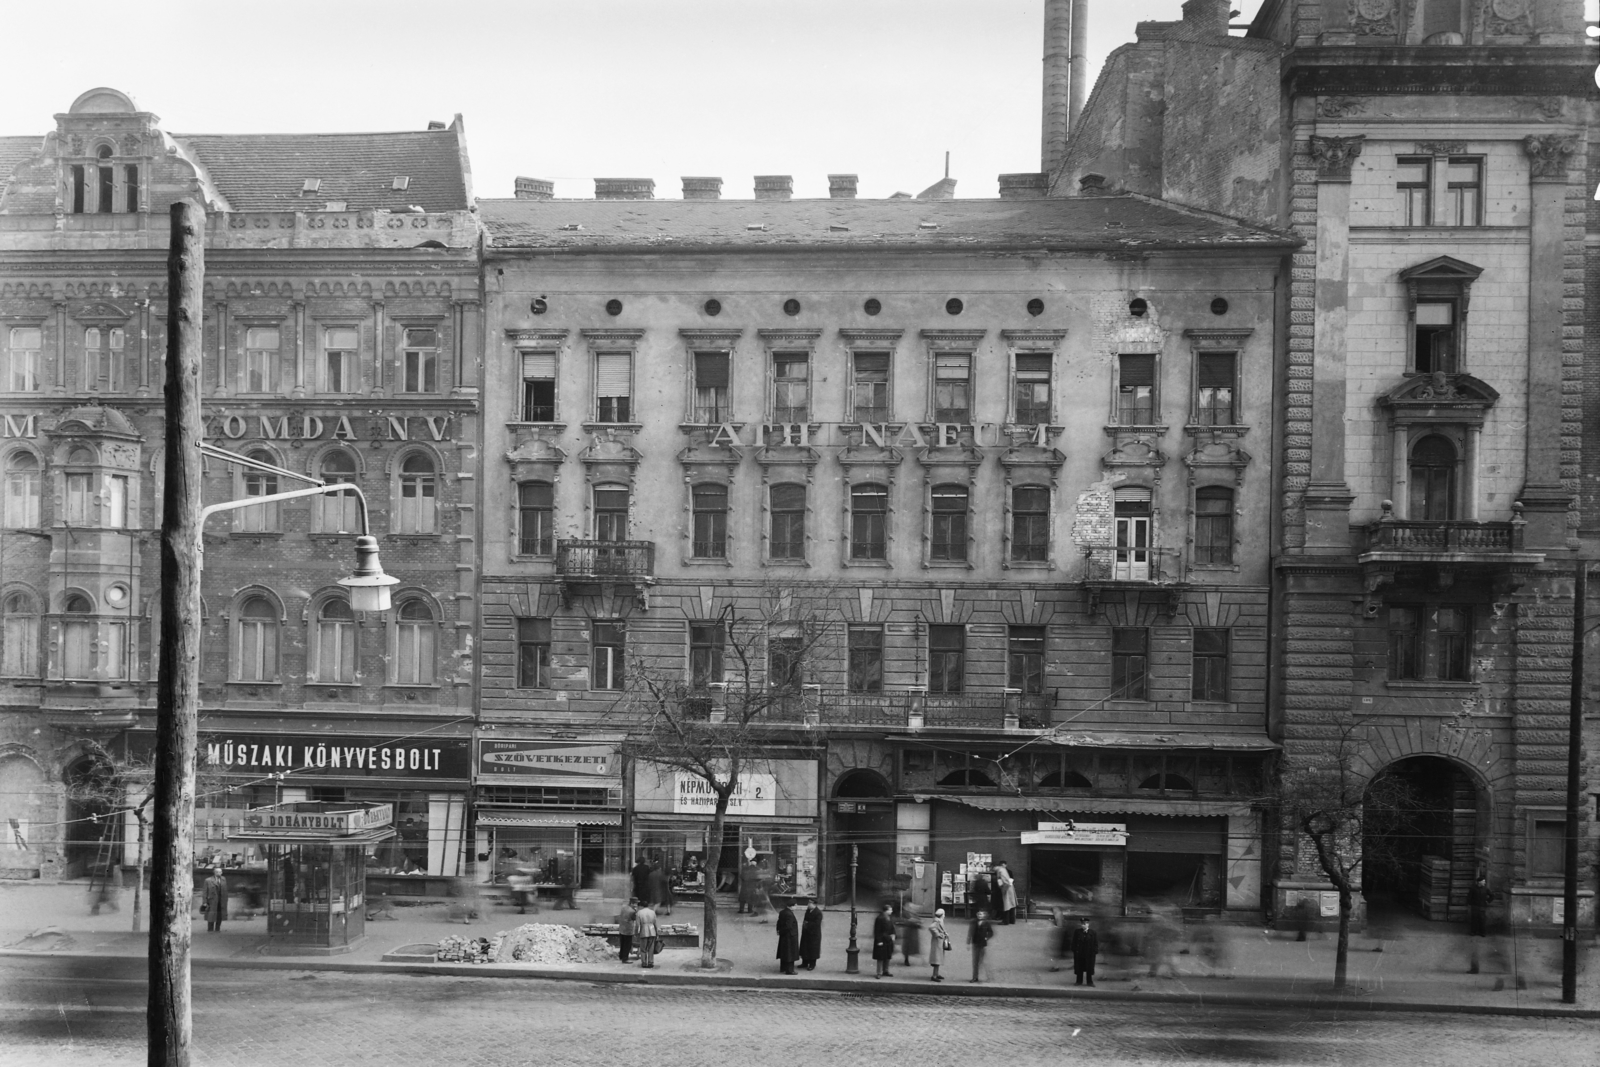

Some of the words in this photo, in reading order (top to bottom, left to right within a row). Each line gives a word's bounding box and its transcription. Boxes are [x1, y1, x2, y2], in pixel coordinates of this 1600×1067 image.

[207, 740, 293, 767] MŰSZAKI
[304, 743, 442, 770] KÖNYVESBOLT
[494, 752, 607, 764] SZÖVETKEZETI
[755, 787, 764, 799] 2.
[680, 794, 688, 806] ÉS
[269, 813, 344, 828] DOHÁNYBOLT
